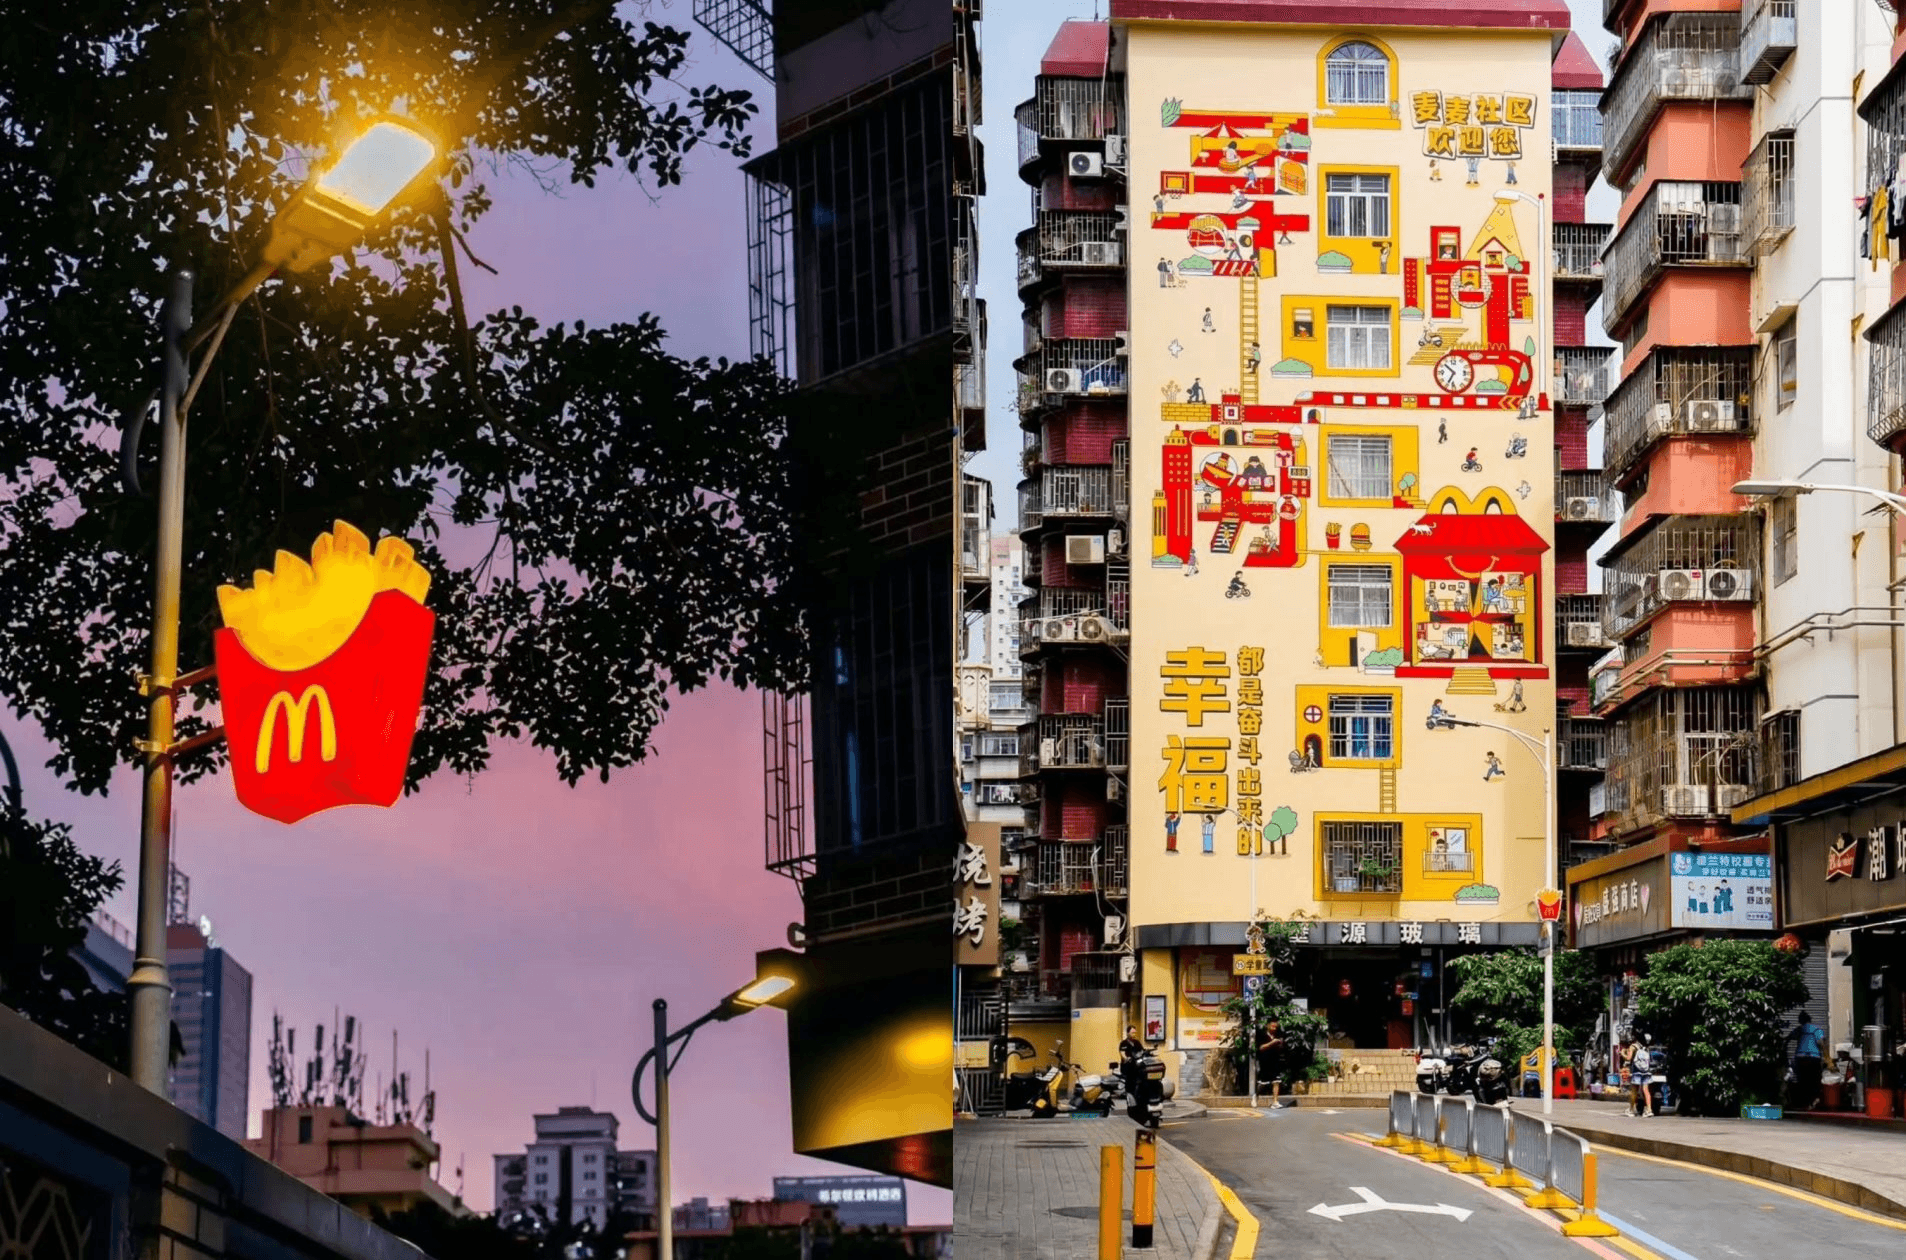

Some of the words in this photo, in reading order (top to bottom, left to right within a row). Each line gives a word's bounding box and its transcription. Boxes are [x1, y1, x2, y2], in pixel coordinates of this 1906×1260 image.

[1413, 92, 1532, 126] 麦麦社区
[1427, 125, 1520, 156] 欢迎您
[1158, 647, 1231, 814] 幸福
[1237, 646, 1264, 855] 都是奋斗出来的
[953, 842, 992, 944] 烧烤
